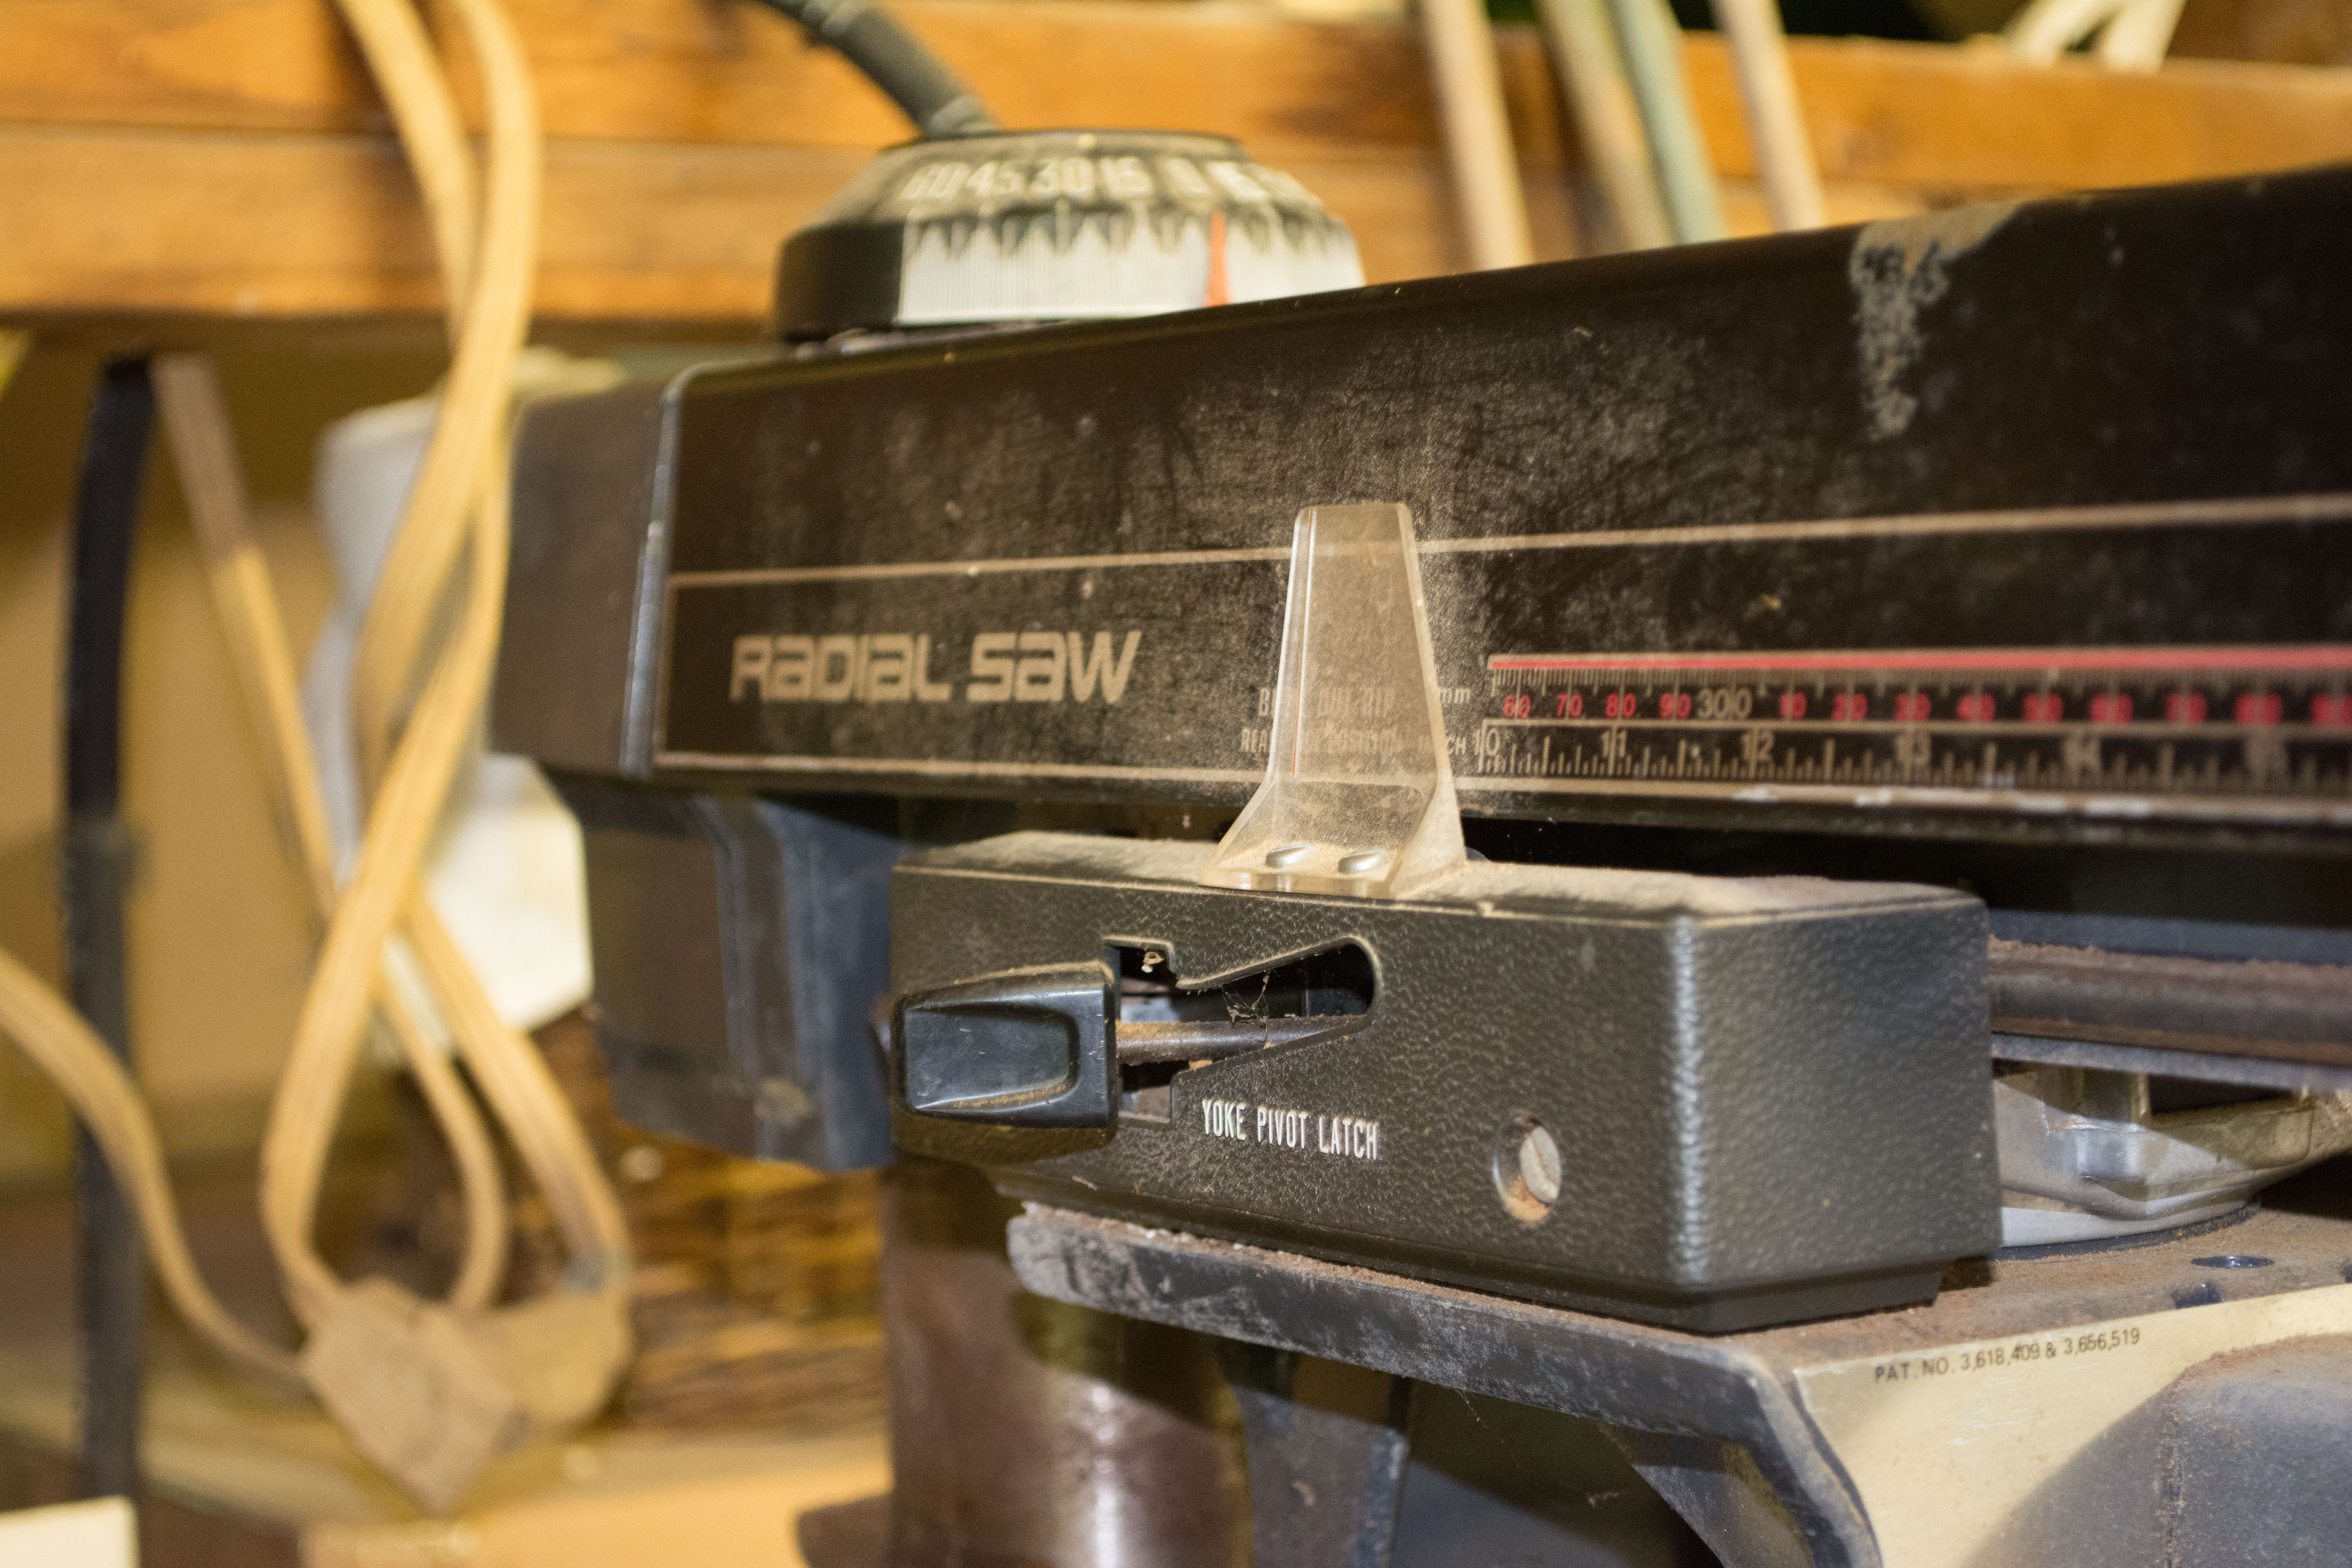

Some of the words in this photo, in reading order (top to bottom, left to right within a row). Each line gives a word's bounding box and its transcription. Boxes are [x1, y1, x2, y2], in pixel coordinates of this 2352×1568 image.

[1503, 694, 1531, 719] 60
[1557, 693, 1583, 719] 70
[1605, 693, 1637, 719] 80
[1659, 693, 1692, 720] 90
[1697, 688, 1753, 720] 300
[1473, 728, 1501, 757] 10
[1601, 730, 1628, 758] 11
[1741, 730, 1775, 761] 12
[1202, 1098, 1246, 1141] YOKE
[1257, 1106, 1308, 1149] PIVOT
[1318, 1116, 1378, 1161] LATCH
[1875, 1362, 1918, 1383] PAT.
[1922, 1356, 1956, 1375] NO.
[2045, 1341, 2057, 1359] &
[2064, 1327, 2140, 1356] 3,656,519
